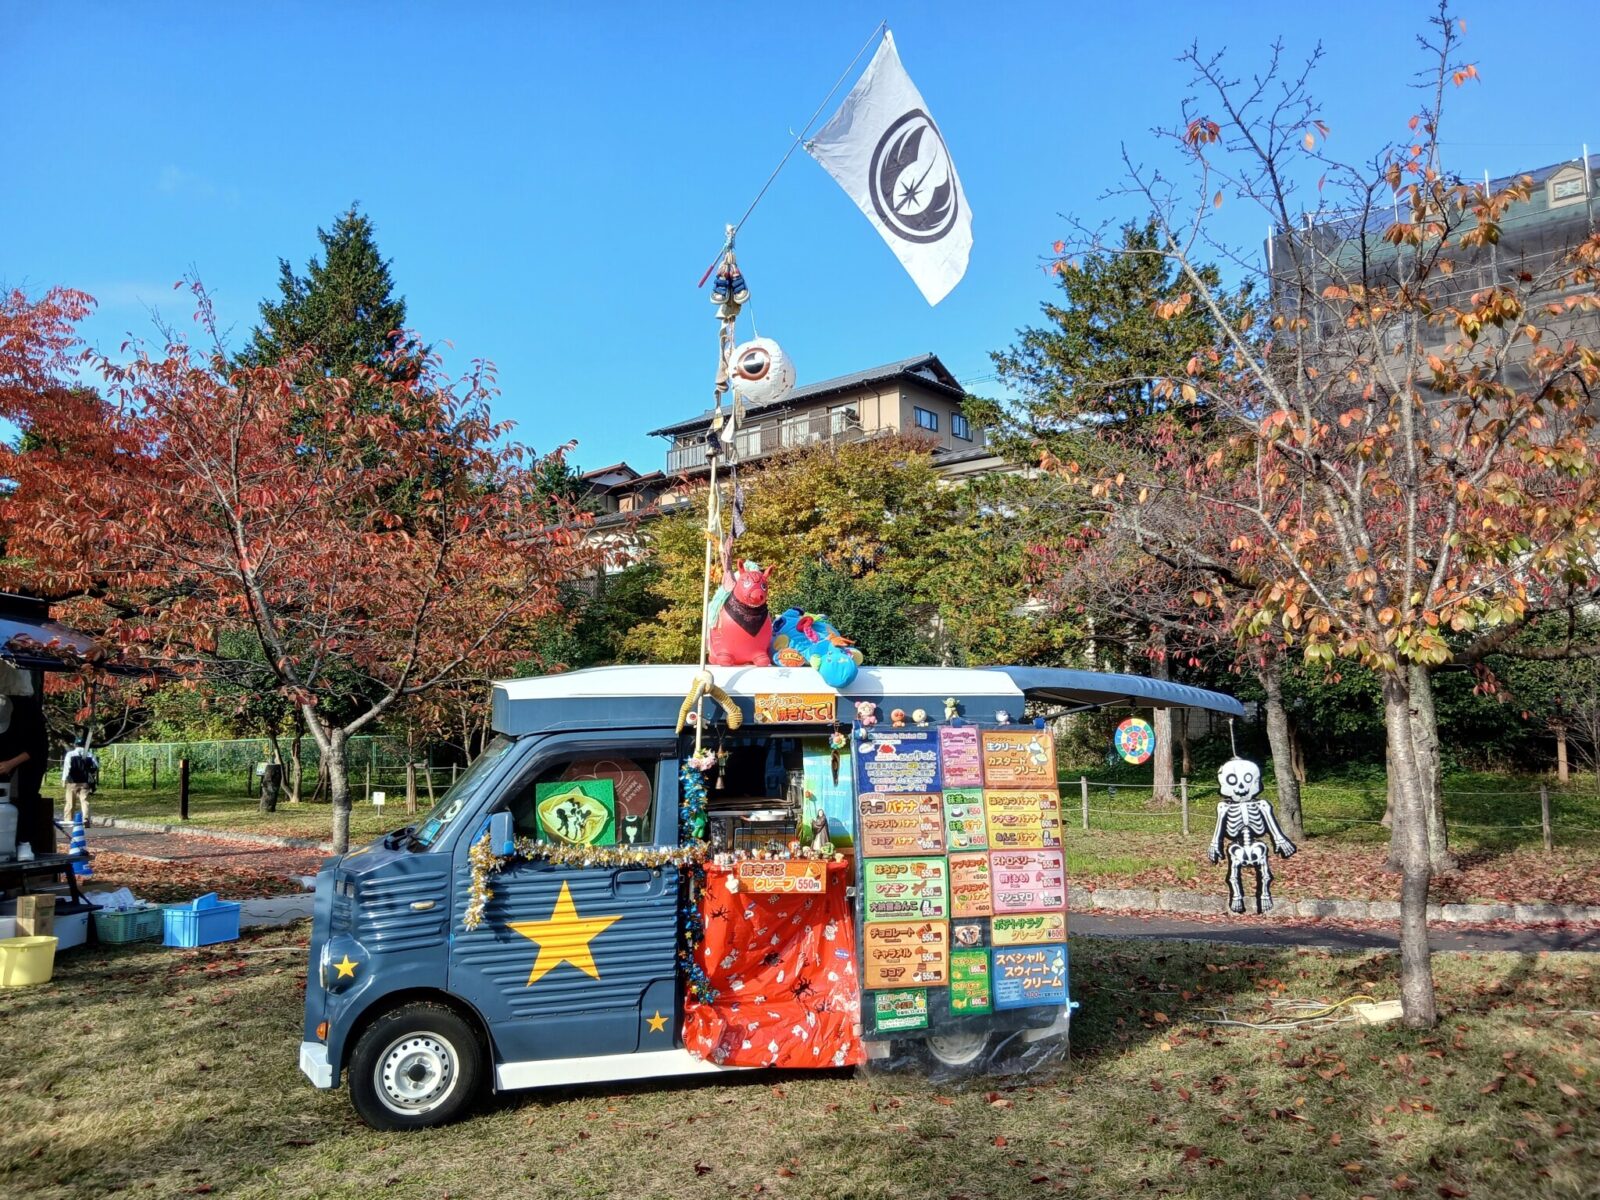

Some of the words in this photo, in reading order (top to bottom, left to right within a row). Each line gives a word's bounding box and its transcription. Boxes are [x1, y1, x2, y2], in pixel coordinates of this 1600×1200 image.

[986, 743, 1026, 752] 生クリーム
[988, 757, 1027, 766] カスタード
[1014, 766, 1046, 775] クリーム
[947, 794, 964, 805] 抹茶
[951, 858, 987, 869] アプリコット
[993, 856, 1036, 865] ストロベリー
[741, 863, 785, 876] 焼きそば
[875, 865, 908, 875] はちみつ
[755, 878, 795, 890] クレープ
[876, 883, 908, 893] シナモン
[952, 882, 988, 894] アプリコット
[998, 892, 1033, 902] マシュマロ
[994, 917, 1044, 930] ポテトサラダ
[870, 927, 915, 938] チョコレート
[1011, 929, 1045, 940] クレープ
[873, 948, 912, 959] キャラメル
[996, 951, 1046, 965] スペシャル
[880, 967, 905, 977] ココア
[1005, 964, 1050, 977] スウィート
[1023, 976, 1062, 989] クリーム
